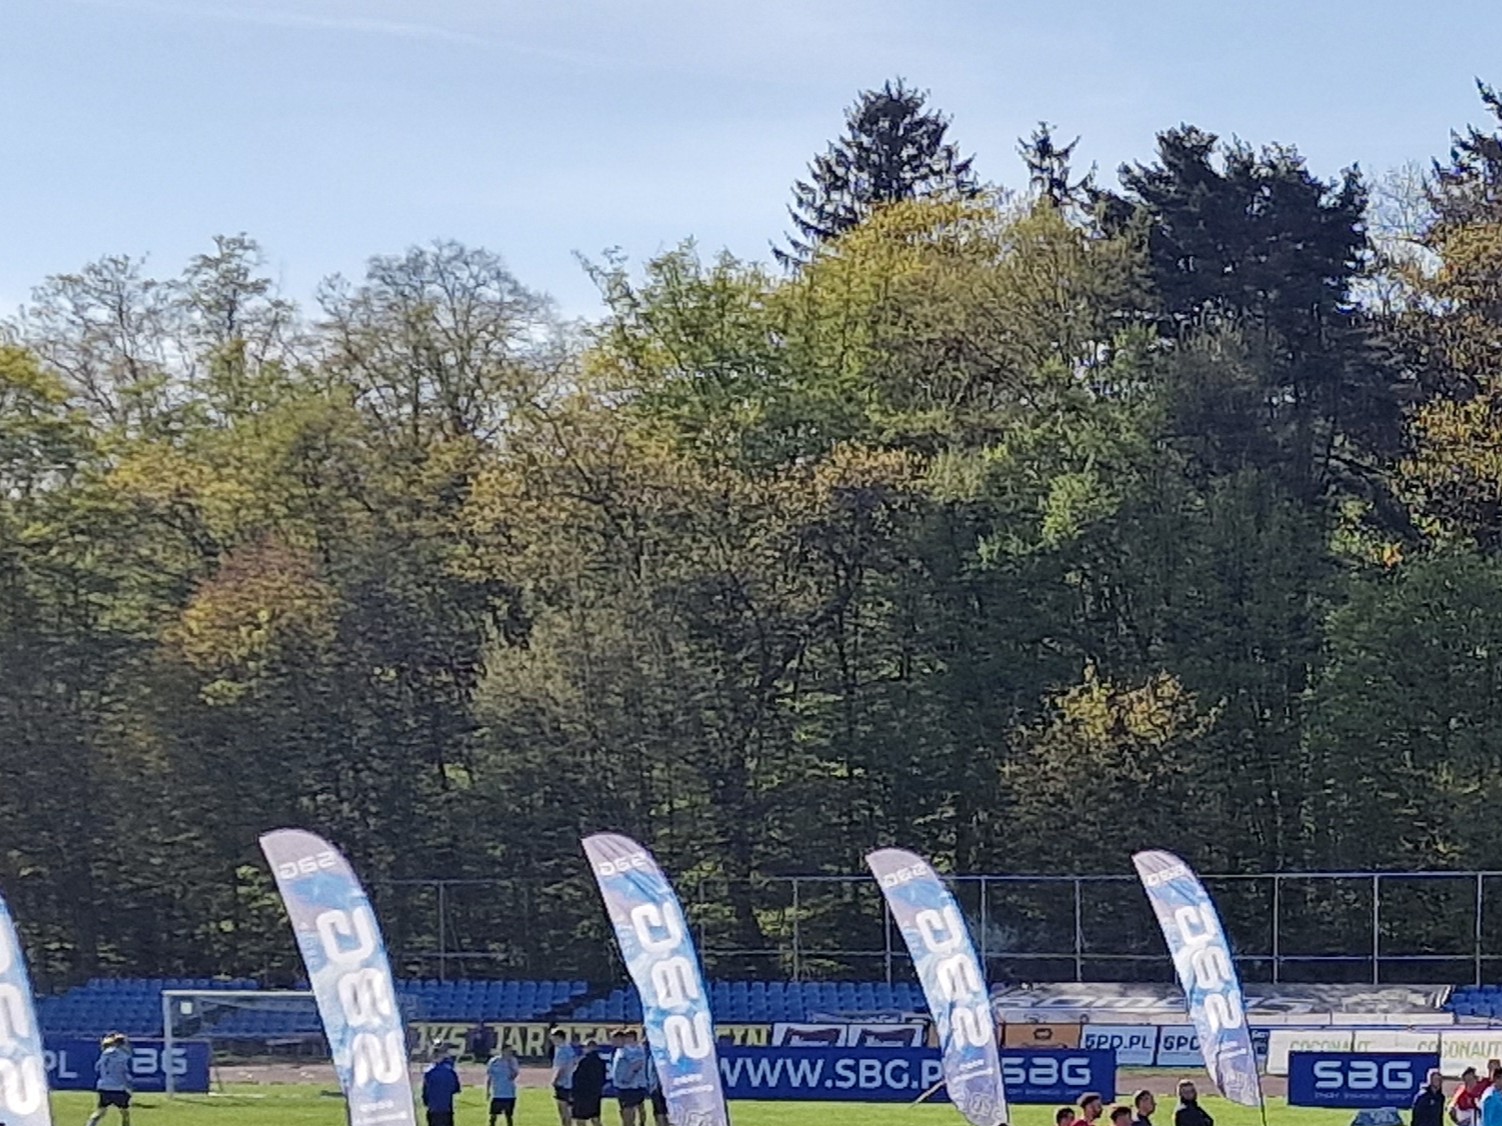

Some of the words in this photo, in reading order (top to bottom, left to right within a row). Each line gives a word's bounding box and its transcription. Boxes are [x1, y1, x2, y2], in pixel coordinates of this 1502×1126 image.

[131, 1048, 188, 1075] BG
[720, 1057, 943, 1089] WWW.SBG.P
[1002, 1057, 1091, 1085] SBG
[1313, 1060, 1413, 1089] SBG
